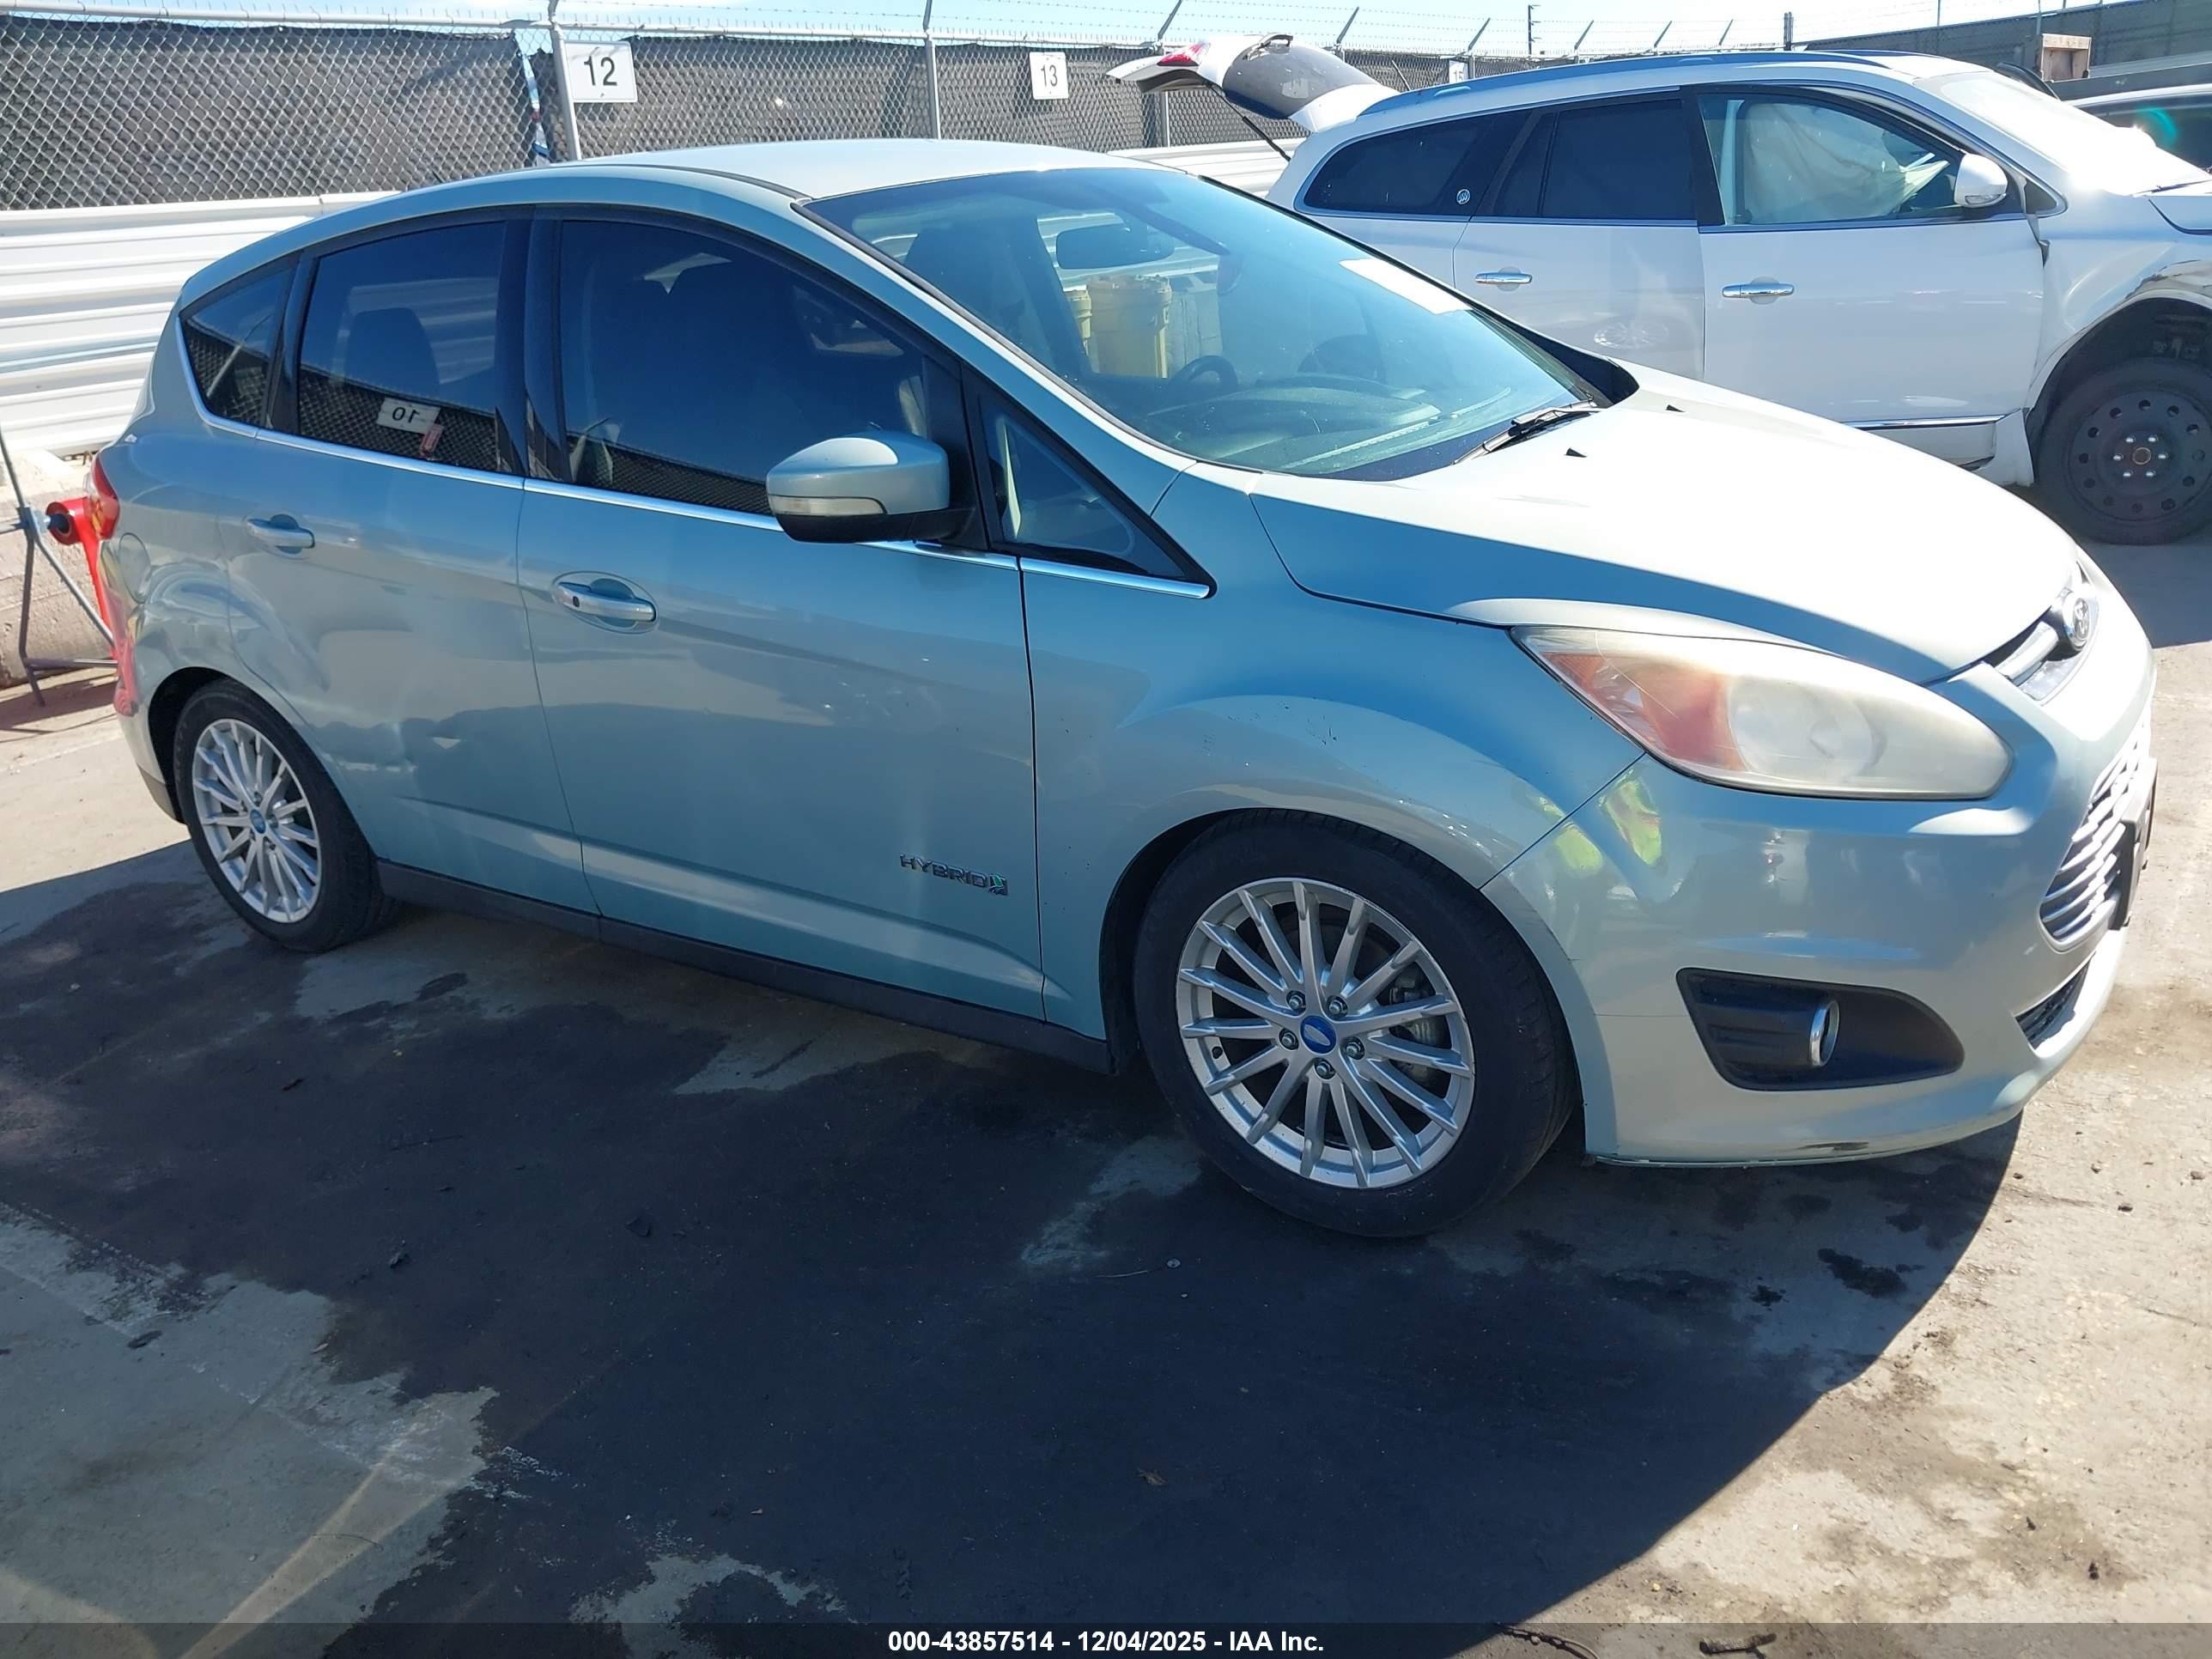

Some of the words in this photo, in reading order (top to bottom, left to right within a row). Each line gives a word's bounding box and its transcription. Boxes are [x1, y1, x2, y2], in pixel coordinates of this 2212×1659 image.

[584, 55, 617, 86] 12
[1041, 64, 1058, 87] 13
[899, 853, 988, 888] HYBRID
